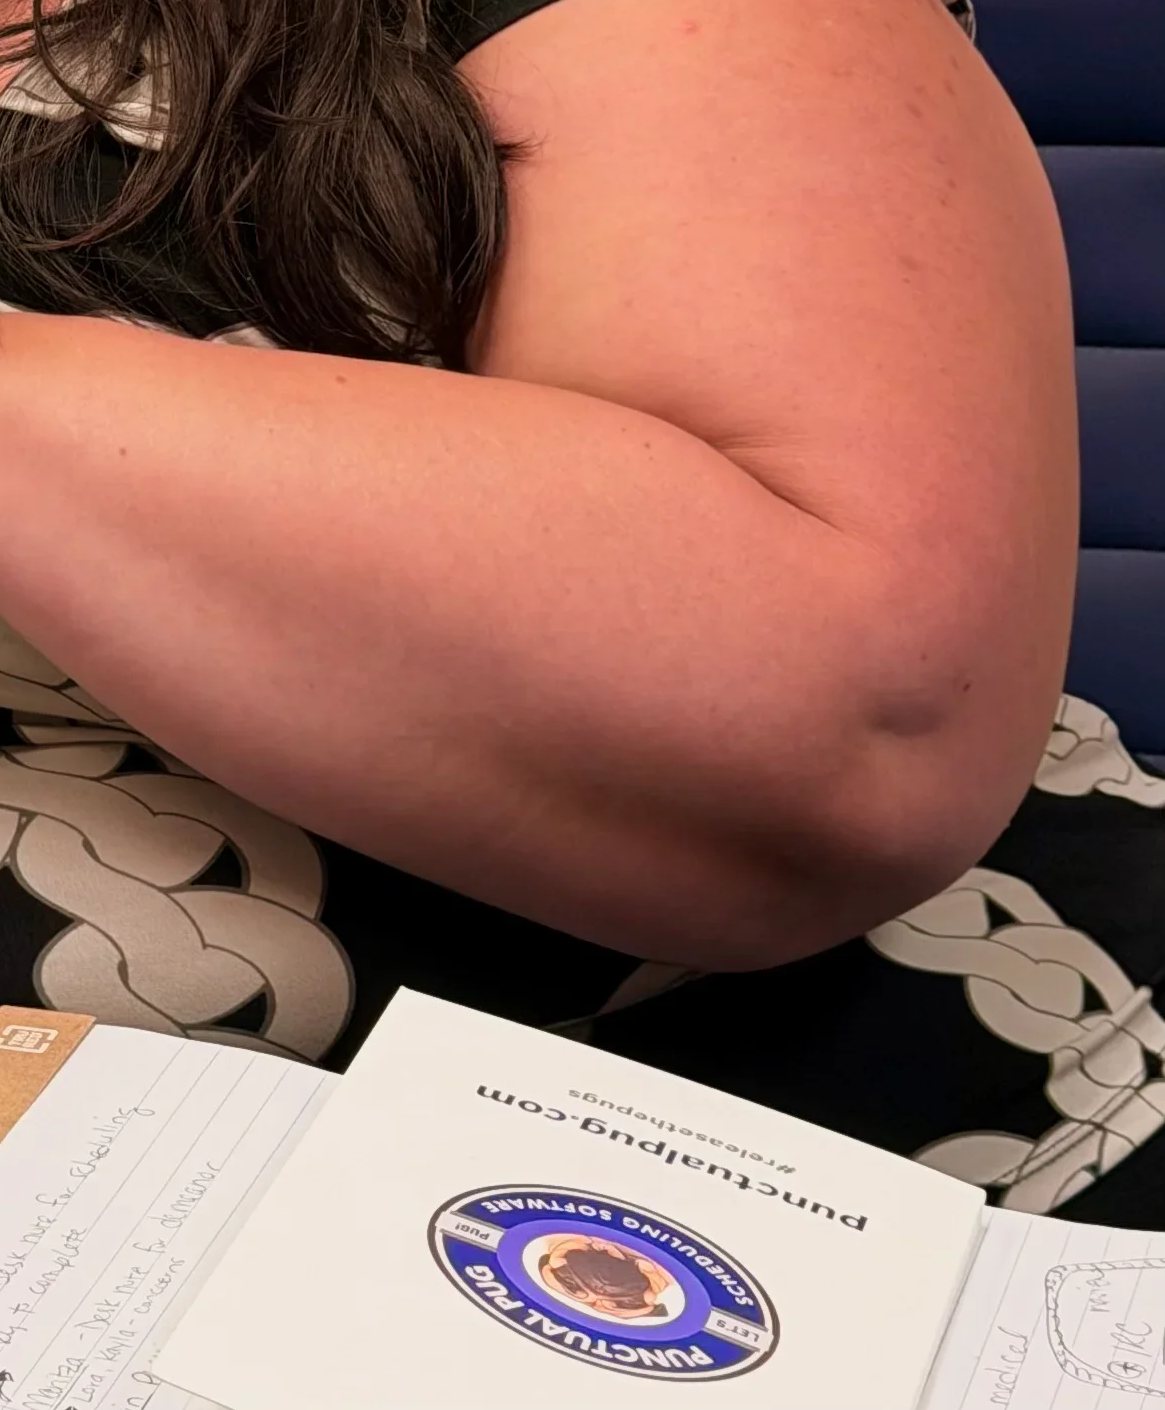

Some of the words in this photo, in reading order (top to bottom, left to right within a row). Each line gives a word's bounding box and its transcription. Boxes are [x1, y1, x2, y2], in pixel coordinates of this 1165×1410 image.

[568, 1088, 797, 1175] #releasethepugs
[476, 1085, 868, 1232] punctualpug.com
[454, 1221, 491, 1242] PUG!
[480, 1197, 613, 1222] SOFTWARE
[622, 1215, 754, 1307] SCHEDULING
[465, 1265, 522, 1312] PUG
[525, 1310, 715, 1369] PUNCTUAL
[716, 1318, 761, 1344] LET'S
